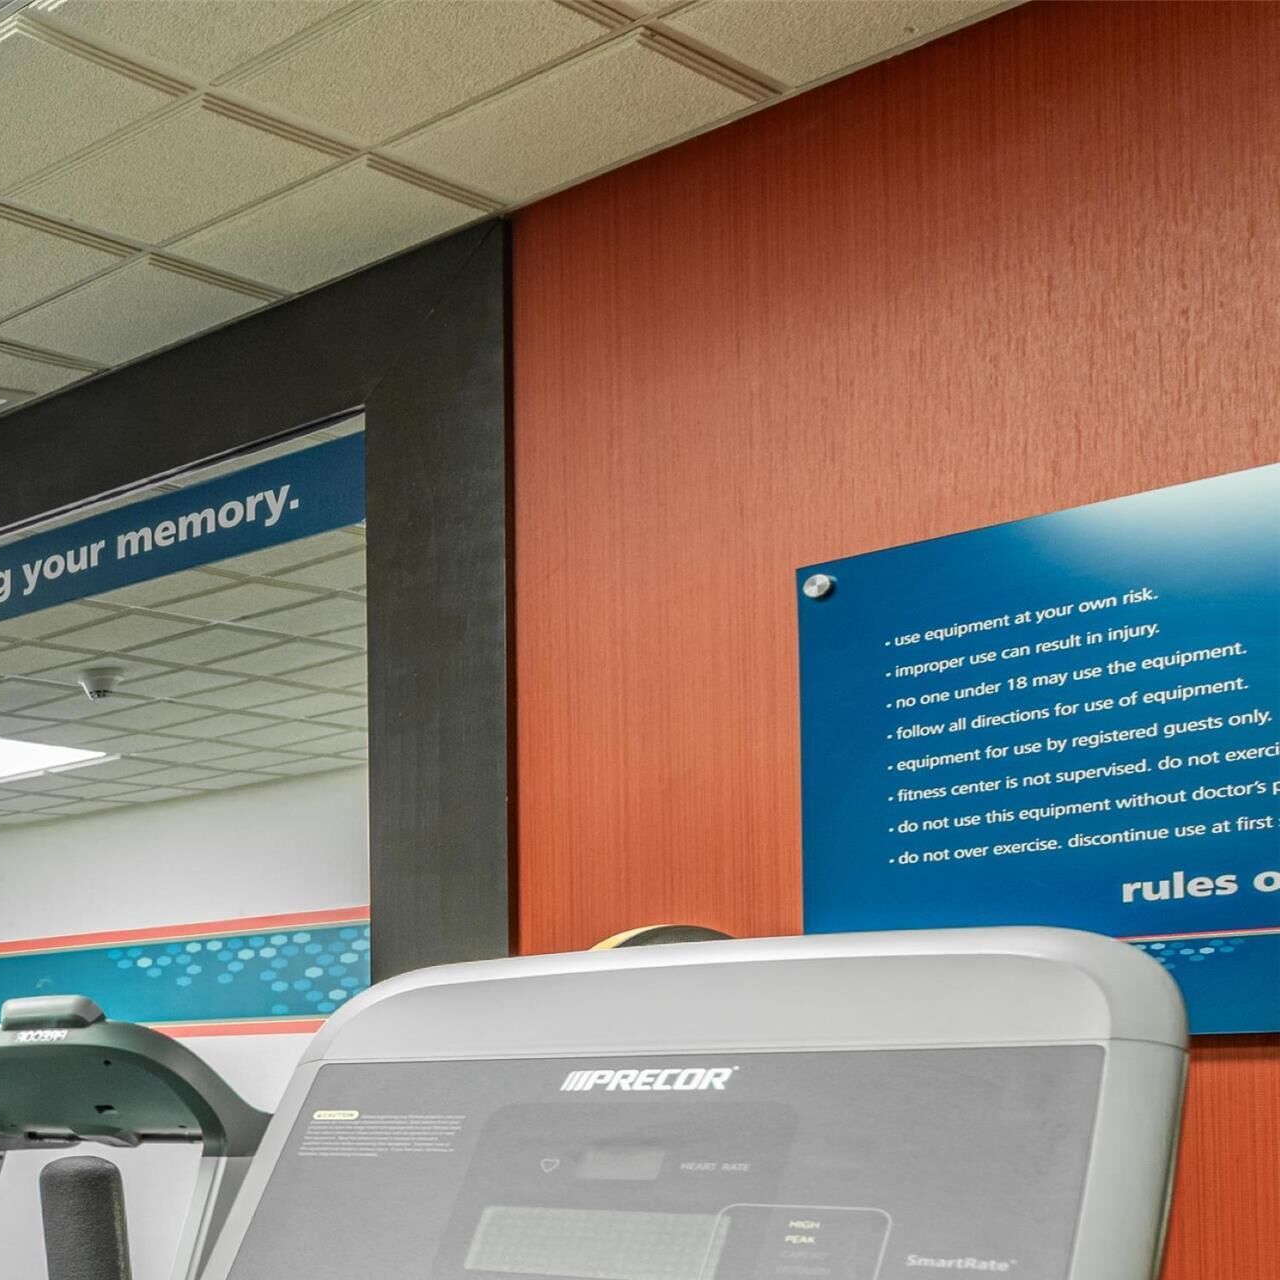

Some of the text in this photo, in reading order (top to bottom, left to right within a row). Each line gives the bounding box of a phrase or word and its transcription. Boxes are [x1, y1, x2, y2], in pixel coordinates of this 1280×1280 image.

[22, 540, 106, 595] your
[116, 485, 300, 559] memory.
[894, 587, 1158, 646] use equipment at your own risk.
[895, 623, 1160, 678] improper use can result in injury.
[896, 642, 1248, 709] no one under 18 may use the equipment.
[896, 677, 1249, 740] follow all directions for use of equipment.
[896, 709, 1273, 772] equipment for use by registered guests only.
[897, 786, 947, 802] fitness
[951, 779, 1001, 796] center
[1006, 775, 1018, 789] is
[1022, 771, 1051, 787] not
[1055, 759, 1151, 783] supervised.
[1158, 755, 1183, 771] do
[1188, 750, 1220, 766] not
[897, 820, 918, 833] do
[922, 816, 949, 830] not
[954, 813, 981, 827] use
[985, 808, 1014, 823] this
[1018, 798, 1111, 821] equipment
[1115, 790, 1187, 809] without
[1192, 780, 1267, 801] doctor's
[898, 851, 919, 864] do
[923, 847, 950, 862] not
[954, 844, 989, 860] over
[993, 838, 1062, 855] exercise.
[1067, 827, 1169, 848] discontinue
[1175, 824, 1206, 838] use
[1211, 820, 1231, 834] at
[1236, 816, 1274, 831] first
[1122, 871, 1238, 903] rules
[578, 1067, 733, 1091] PRECOR
